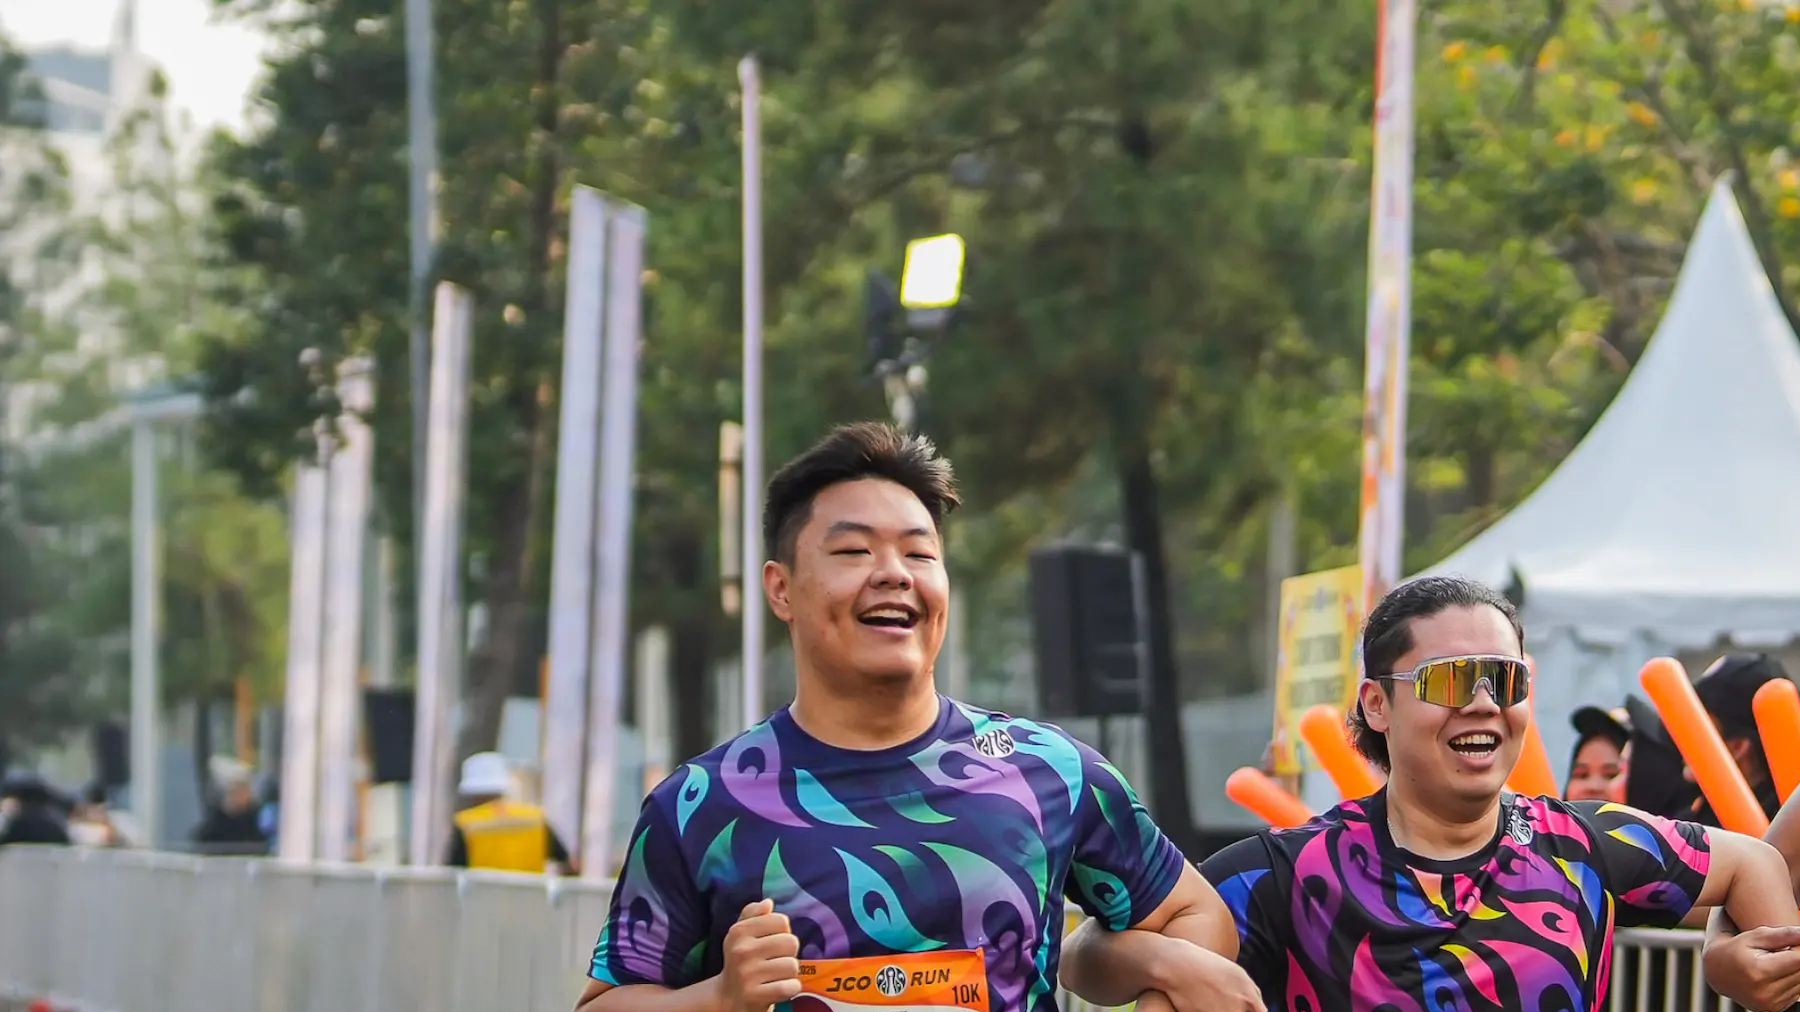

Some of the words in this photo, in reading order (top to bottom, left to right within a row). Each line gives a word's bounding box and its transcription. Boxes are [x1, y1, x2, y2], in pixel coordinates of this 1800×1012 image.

[826, 975, 872, 992] JCO
[910, 968, 950, 987] RUN
[952, 983, 981, 1005] 10K
